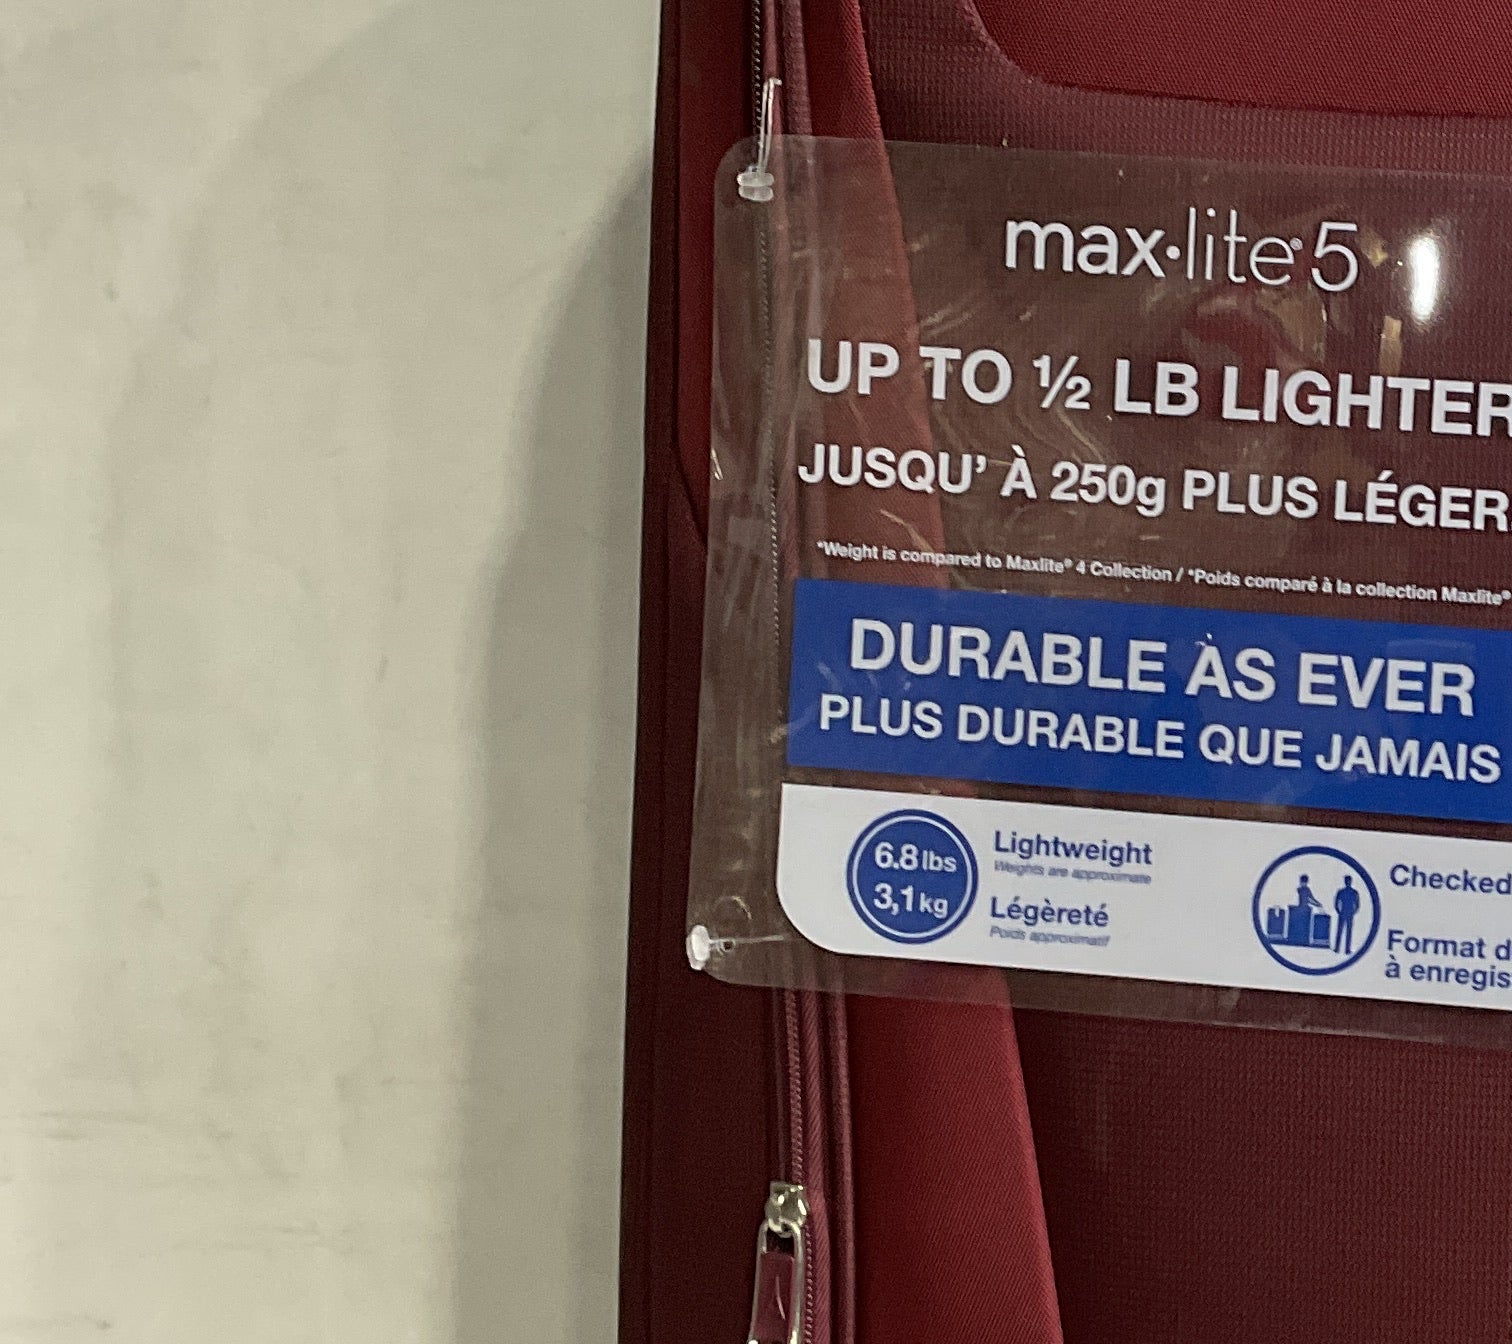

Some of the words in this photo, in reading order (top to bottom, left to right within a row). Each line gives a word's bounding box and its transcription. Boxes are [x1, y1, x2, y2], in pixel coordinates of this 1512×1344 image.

[807, 337, 901, 396] UP
[918, 345, 1013, 405] TO
[1112, 358, 1200, 417] LB
[1000, 444, 1038, 500] À
[1049, 460, 1167, 518] 250g
[1183, 469, 1320, 519] PLUS
[882, 545, 897, 562] is
[899, 550, 982, 567] compared
[985, 554, 1003, 570] to
[1075, 561, 1087, 575] 4
[1089, 561, 1173, 582] Collection
[1244, 575, 1319, 594] comparé
[1321, 576, 1333, 594] à
[1335, 578, 1352, 595] la
[1354, 582, 1439, 601] collection
[850, 617, 1168, 695] DURABLE
[1298, 652, 1476, 718] EVER
[819, 693, 944, 741] PLUS
[956, 702, 1186, 760] DURABLE
[1198, 724, 1303, 770] QUE
[1315, 736, 1502, 785] JAMAIS
[993, 830, 1153, 867] Lightweight
[1389, 863, 1512, 896] Checked
[990, 895, 1109, 927] Légèreté
[1384, 955, 1401, 979] à
[1387, 929, 1486, 960] Format
